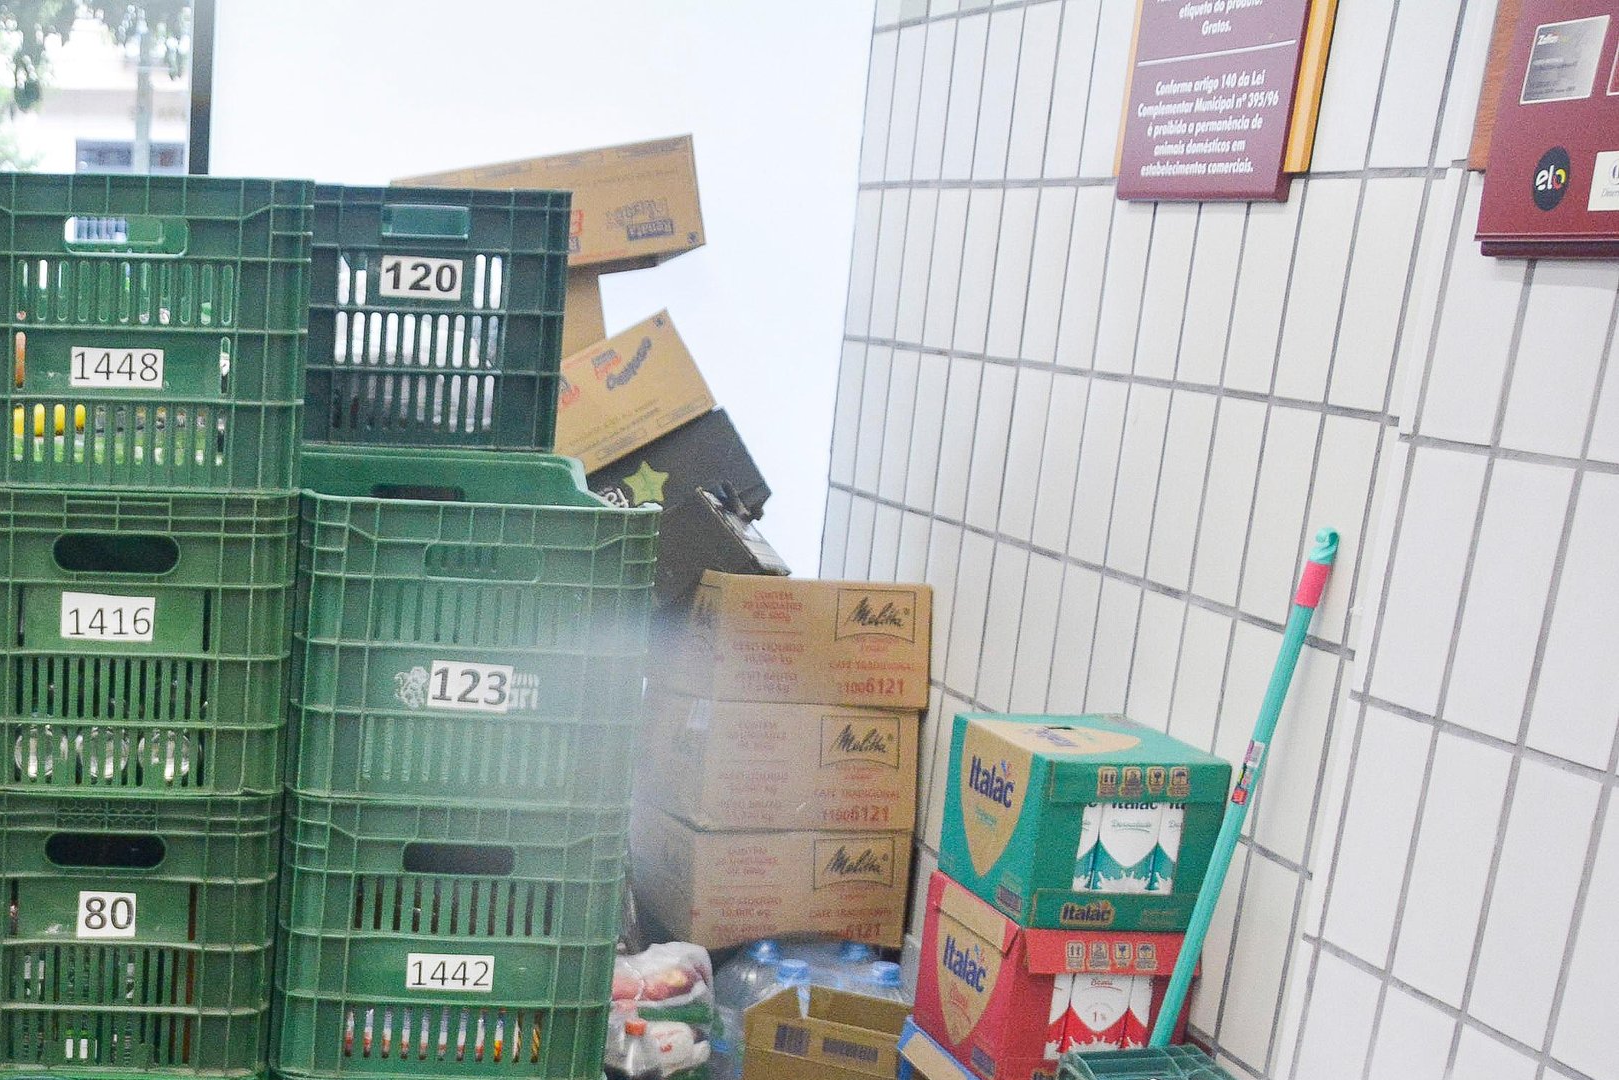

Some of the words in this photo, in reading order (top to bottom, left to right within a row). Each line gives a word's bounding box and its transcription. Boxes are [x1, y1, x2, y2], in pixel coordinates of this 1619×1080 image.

[1179, 3, 1212, 19] etiqueta
[1214, 0, 1225, 14] do
[1202, 20, 1232, 35] Gratos.
[1156, 80, 1193, 97] Conforme
[1194, 75, 1218, 94] artigo
[1221, 73, 1237, 89] 140
[1238, 71, 1250, 87] da
[1251, 69, 1265, 86] Lei
[1138, 101, 1193, 119] Complementar
[1195, 95, 1233, 115] Municipal
[1248, 90, 1280, 108] 395/96
[1147, 122, 1153, 137] é
[1188, 122, 1194, 134] a
[1195, 114, 1250, 136] permanência
[1250, 113, 1263, 129] de
[1154, 141, 1185, 157] animais
[1186, 137, 1230, 155] domésticos
[1231, 139, 1246, 151] em
[1141, 160, 1206, 178] estabelecimentos
[1207, 157, 1254, 174] comerciais.
[1535, 165, 1566, 191] elo
[385, 261, 458, 292] 120
[74, 352, 158, 382] 1448
[69, 607, 151, 635] 1416
[432, 667, 508, 706] 123
[968, 754, 1015, 809] Italac
[85, 897, 135, 930] 80
[1063, 903, 1112, 922] Italac
[412, 960, 489, 986] 1442
[943, 934, 988, 993] Italac
